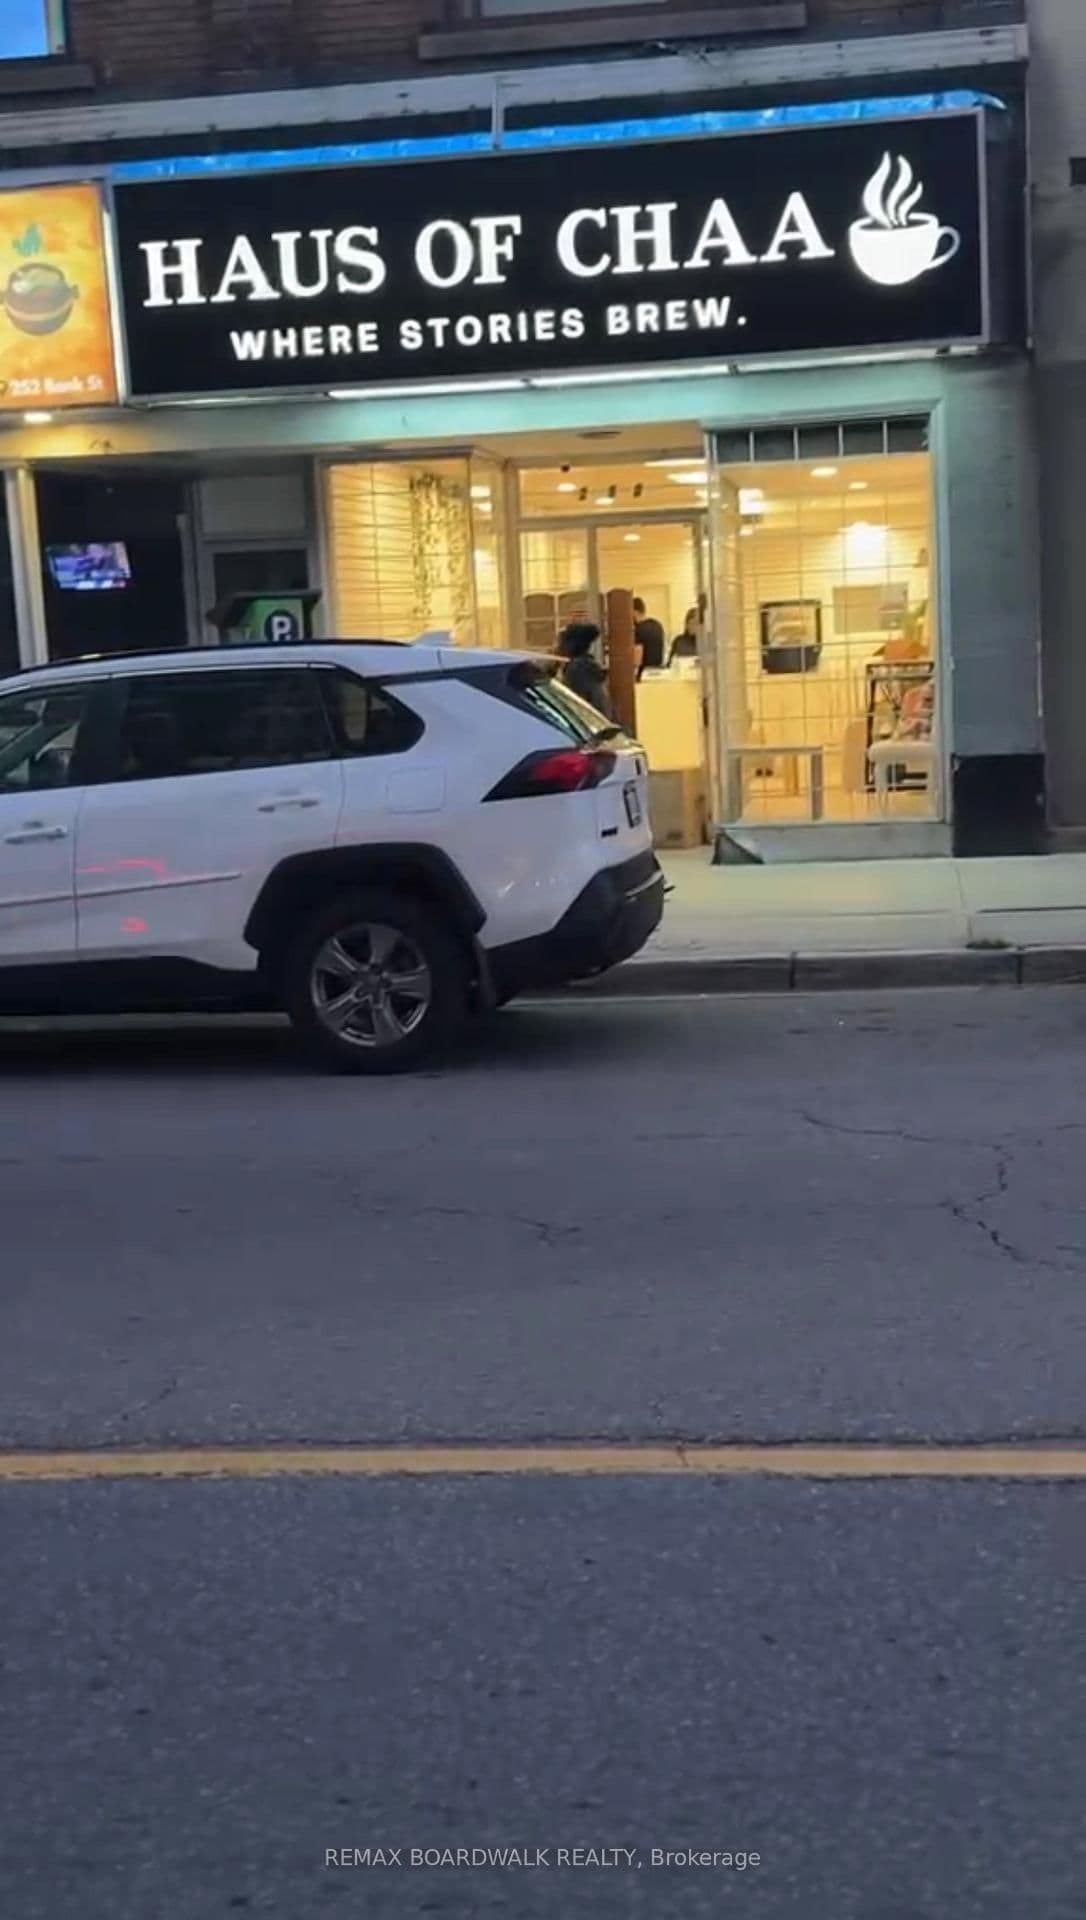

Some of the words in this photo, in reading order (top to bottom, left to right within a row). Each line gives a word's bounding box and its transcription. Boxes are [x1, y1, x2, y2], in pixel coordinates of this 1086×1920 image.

[138, 225, 387, 308] HAUS
[414, 214, 522, 289] OF
[556, 191, 836, 278] CHAA
[229, 322, 379, 361] WHERE
[399, 307, 585, 350] STORIES
[606, 296, 747, 336] BREW.
